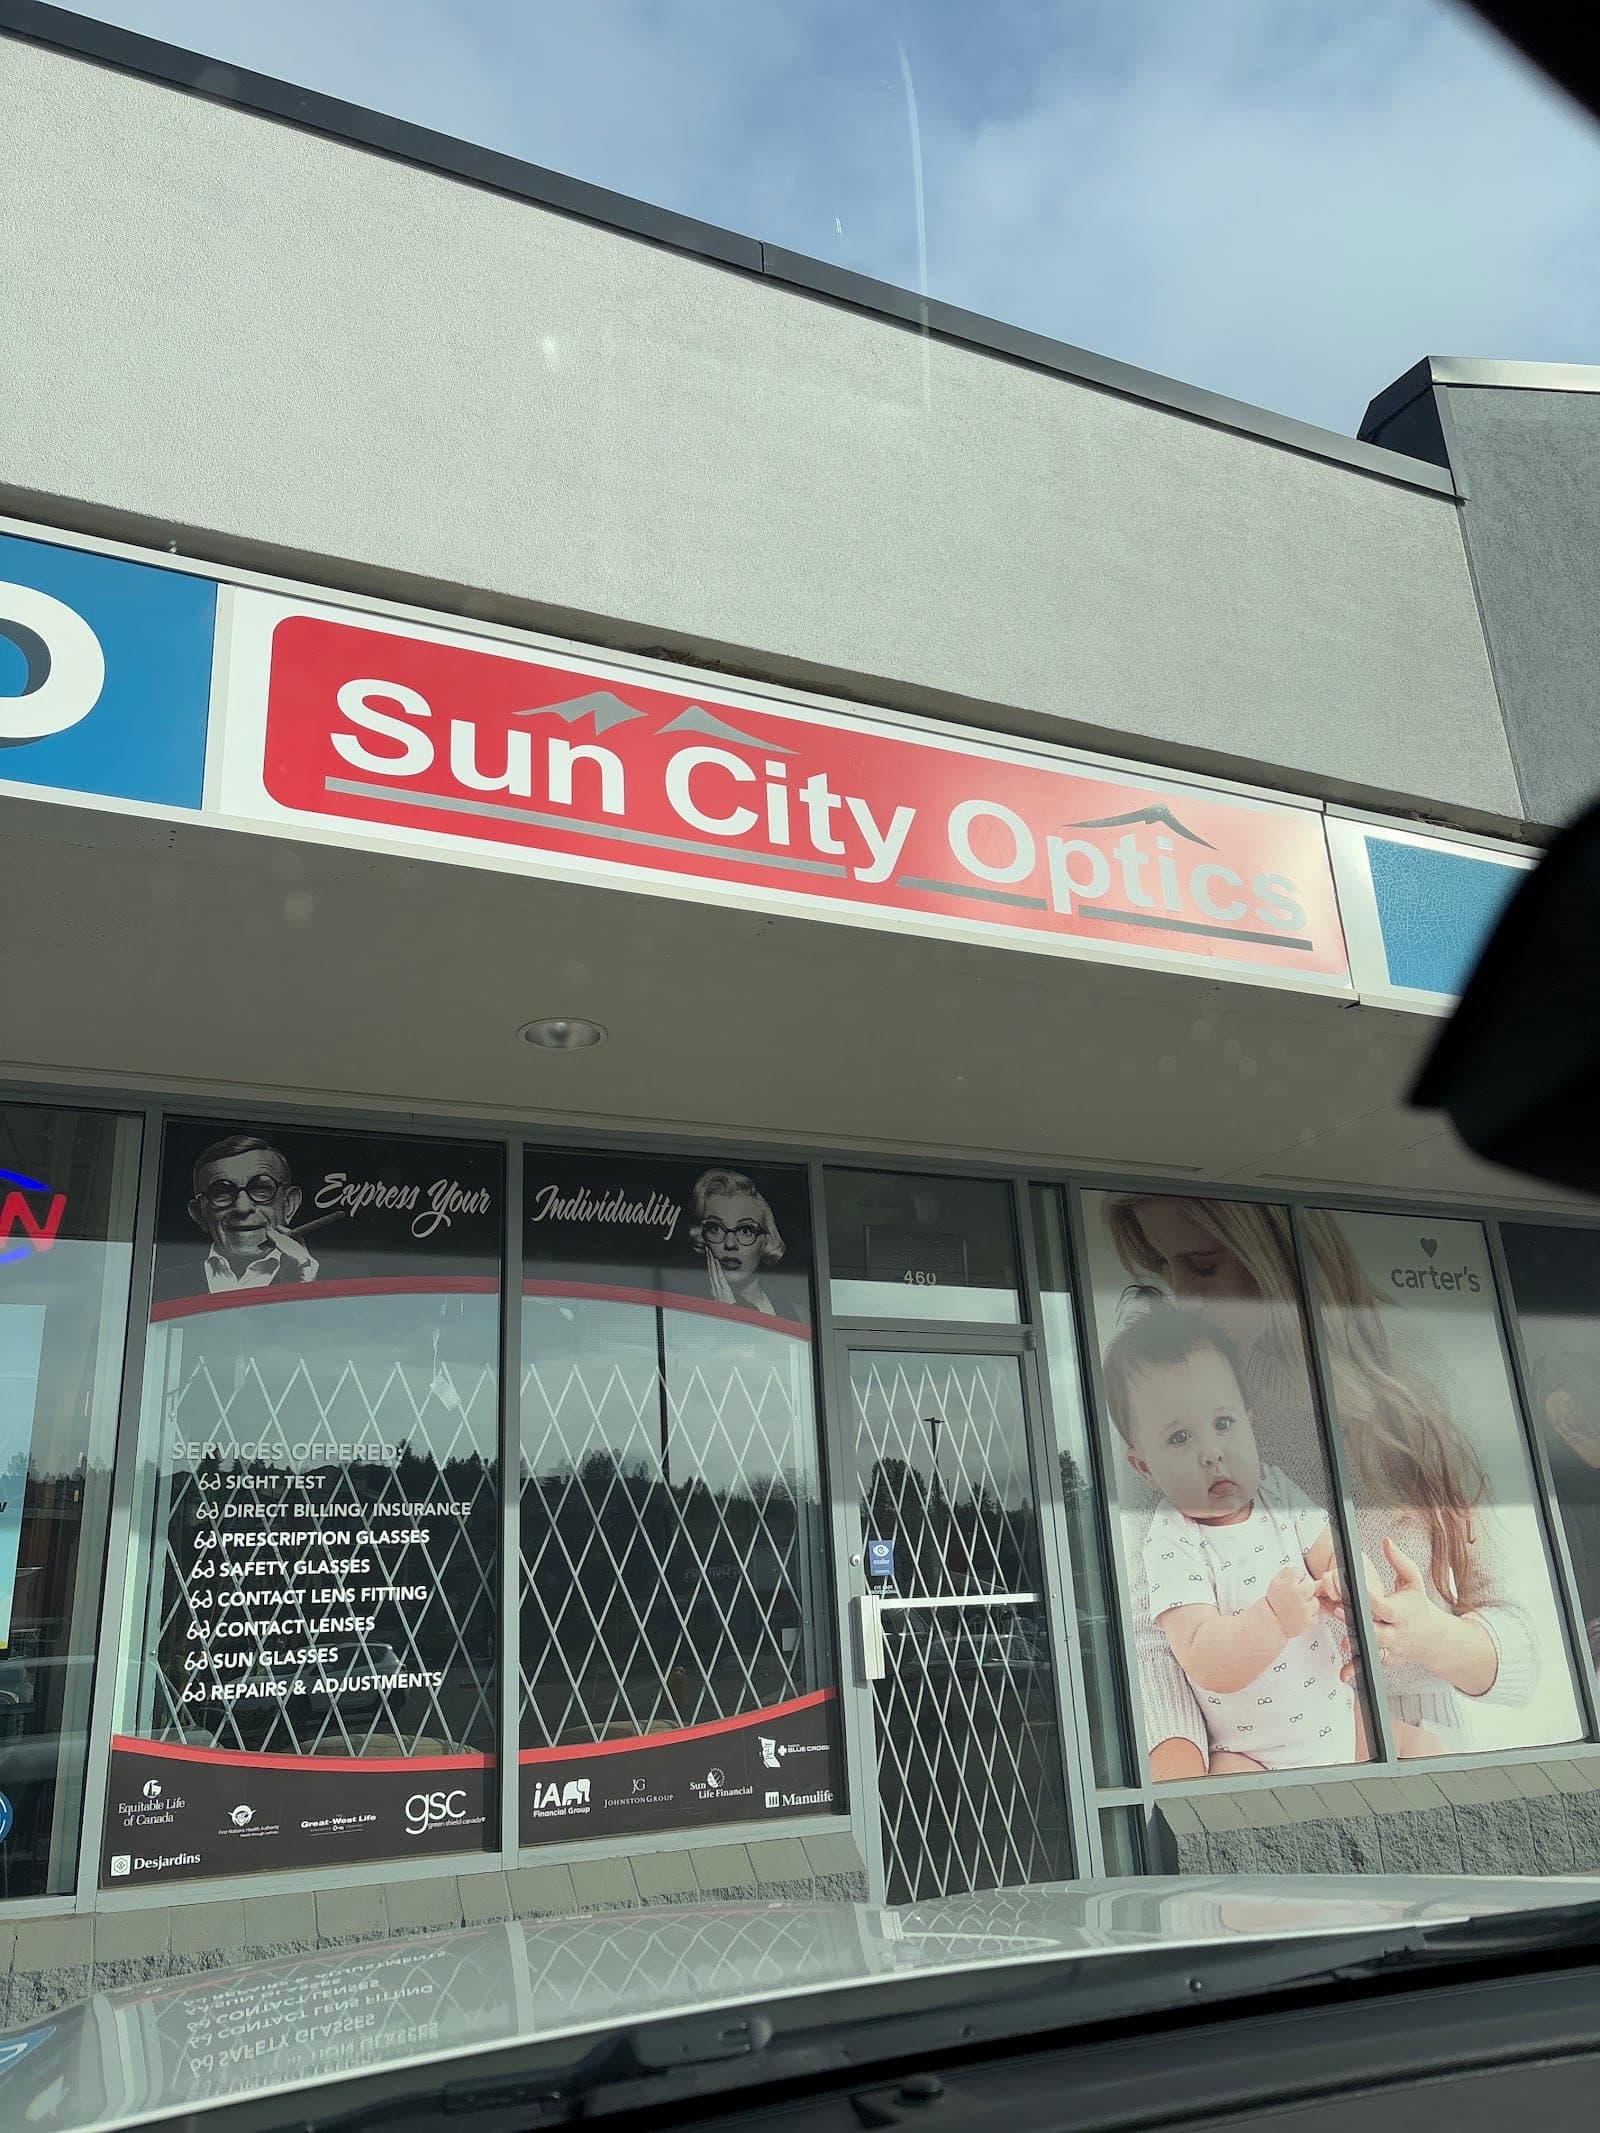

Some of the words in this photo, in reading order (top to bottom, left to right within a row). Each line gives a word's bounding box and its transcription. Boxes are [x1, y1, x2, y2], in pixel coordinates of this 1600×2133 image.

[330, 679, 626, 815] Sun
[665, 746, 917, 884] City
[947, 799, 1306, 931] Optics
[314, 1172, 421, 1218] Express
[411, 1179, 491, 1238] Your
[531, 1184, 682, 1241] Individuality
[903, 1270, 937, 1285] 460
[1390, 1266, 1481, 1293] carter's
[171, 1441, 284, 1461] SERVICES
[291, 1442, 403, 1461] OFFERED:
[225, 1475, 280, 1489] SIGHT
[284, 1475, 326, 1489] TEST
[223, 1503, 289, 1518] DIRECT
[293, 1502, 369, 1518] BILLING/
[373, 1502, 472, 1517] INSURANCE
[221, 1530, 351, 1548] PRESCRIPTION
[355, 1529, 430, 1545] GLASSES
[219, 1561, 289, 1578] SAFETY
[293, 1559, 371, 1575] GLASSES
[217, 1589, 307, 1608] CONTACT
[311, 1587, 356, 1604] LENS
[361, 1585, 428, 1602] FITTING
[215, 1619, 306, 1638] CONTACT
[309, 1616, 376, 1633] LENSES
[213, 1651, 254, 1669] SUN
[259, 1647, 339, 1666] GLASSES
[210, 1680, 288, 1701] REPAIRS
[293, 1679, 307, 1696] &
[311, 1672, 442, 1694] ADJUSTMENTS
[690, 1781, 706, 1790] Sun
[699, 1789, 715, 1799] Life
[716, 1785, 753, 1797] Financial
[118, 1799, 164, 1816] Equitable
[166, 1797, 186, 1809] Life
[782, 1789, 834, 1807] Manulife
[123, 1815, 135, 1826] of
[136, 1812, 174, 1825] Canada
[300, 1817, 357, 1828] Great-West
[358, 1814, 377, 1822] Life
[405, 1789, 467, 1835] gsc
[533, 1808, 566, 1818] Financial
[568, 1806, 591, 1815] Group
[134, 1852, 201, 1871] Desjardins
